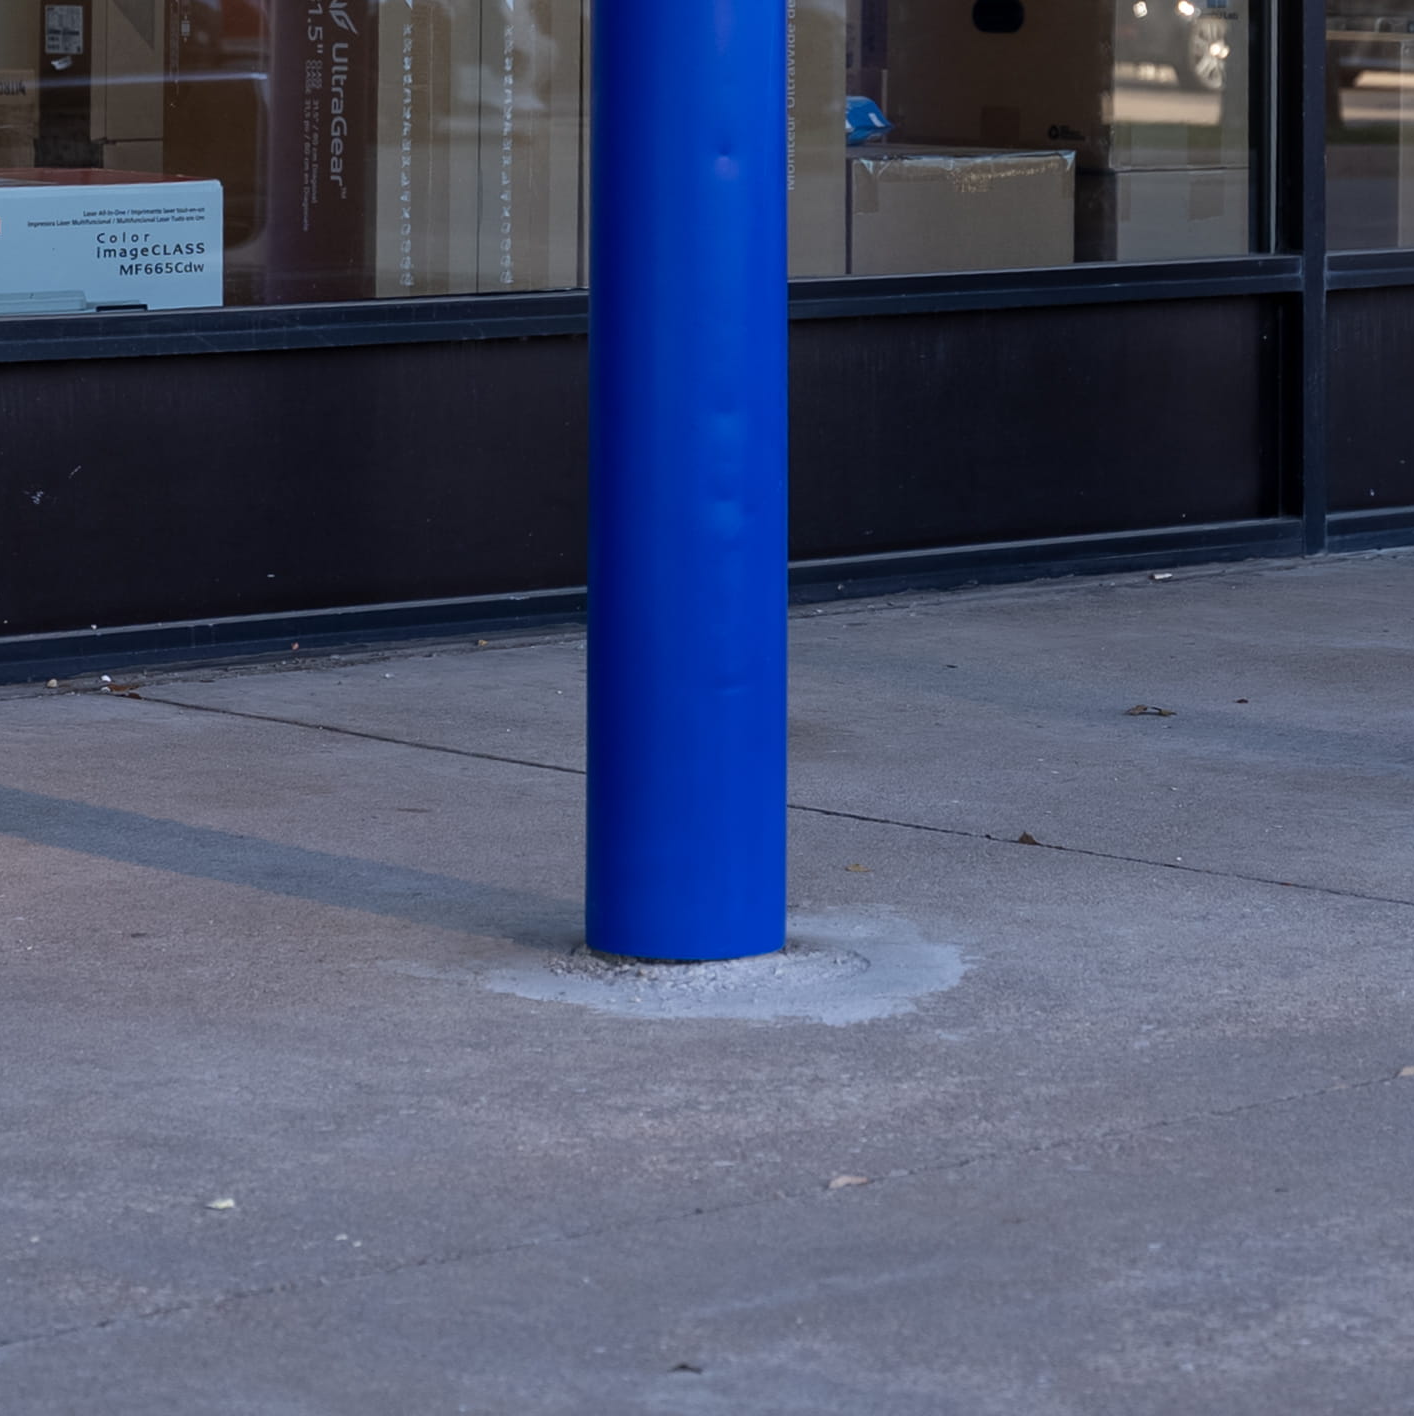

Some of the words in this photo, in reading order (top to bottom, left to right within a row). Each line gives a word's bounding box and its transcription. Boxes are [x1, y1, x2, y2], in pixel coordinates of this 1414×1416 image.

[96, 232, 151, 245] Color
[96, 242, 206, 260] imageCLASS
[118, 261, 205, 277] MF665Cdw
